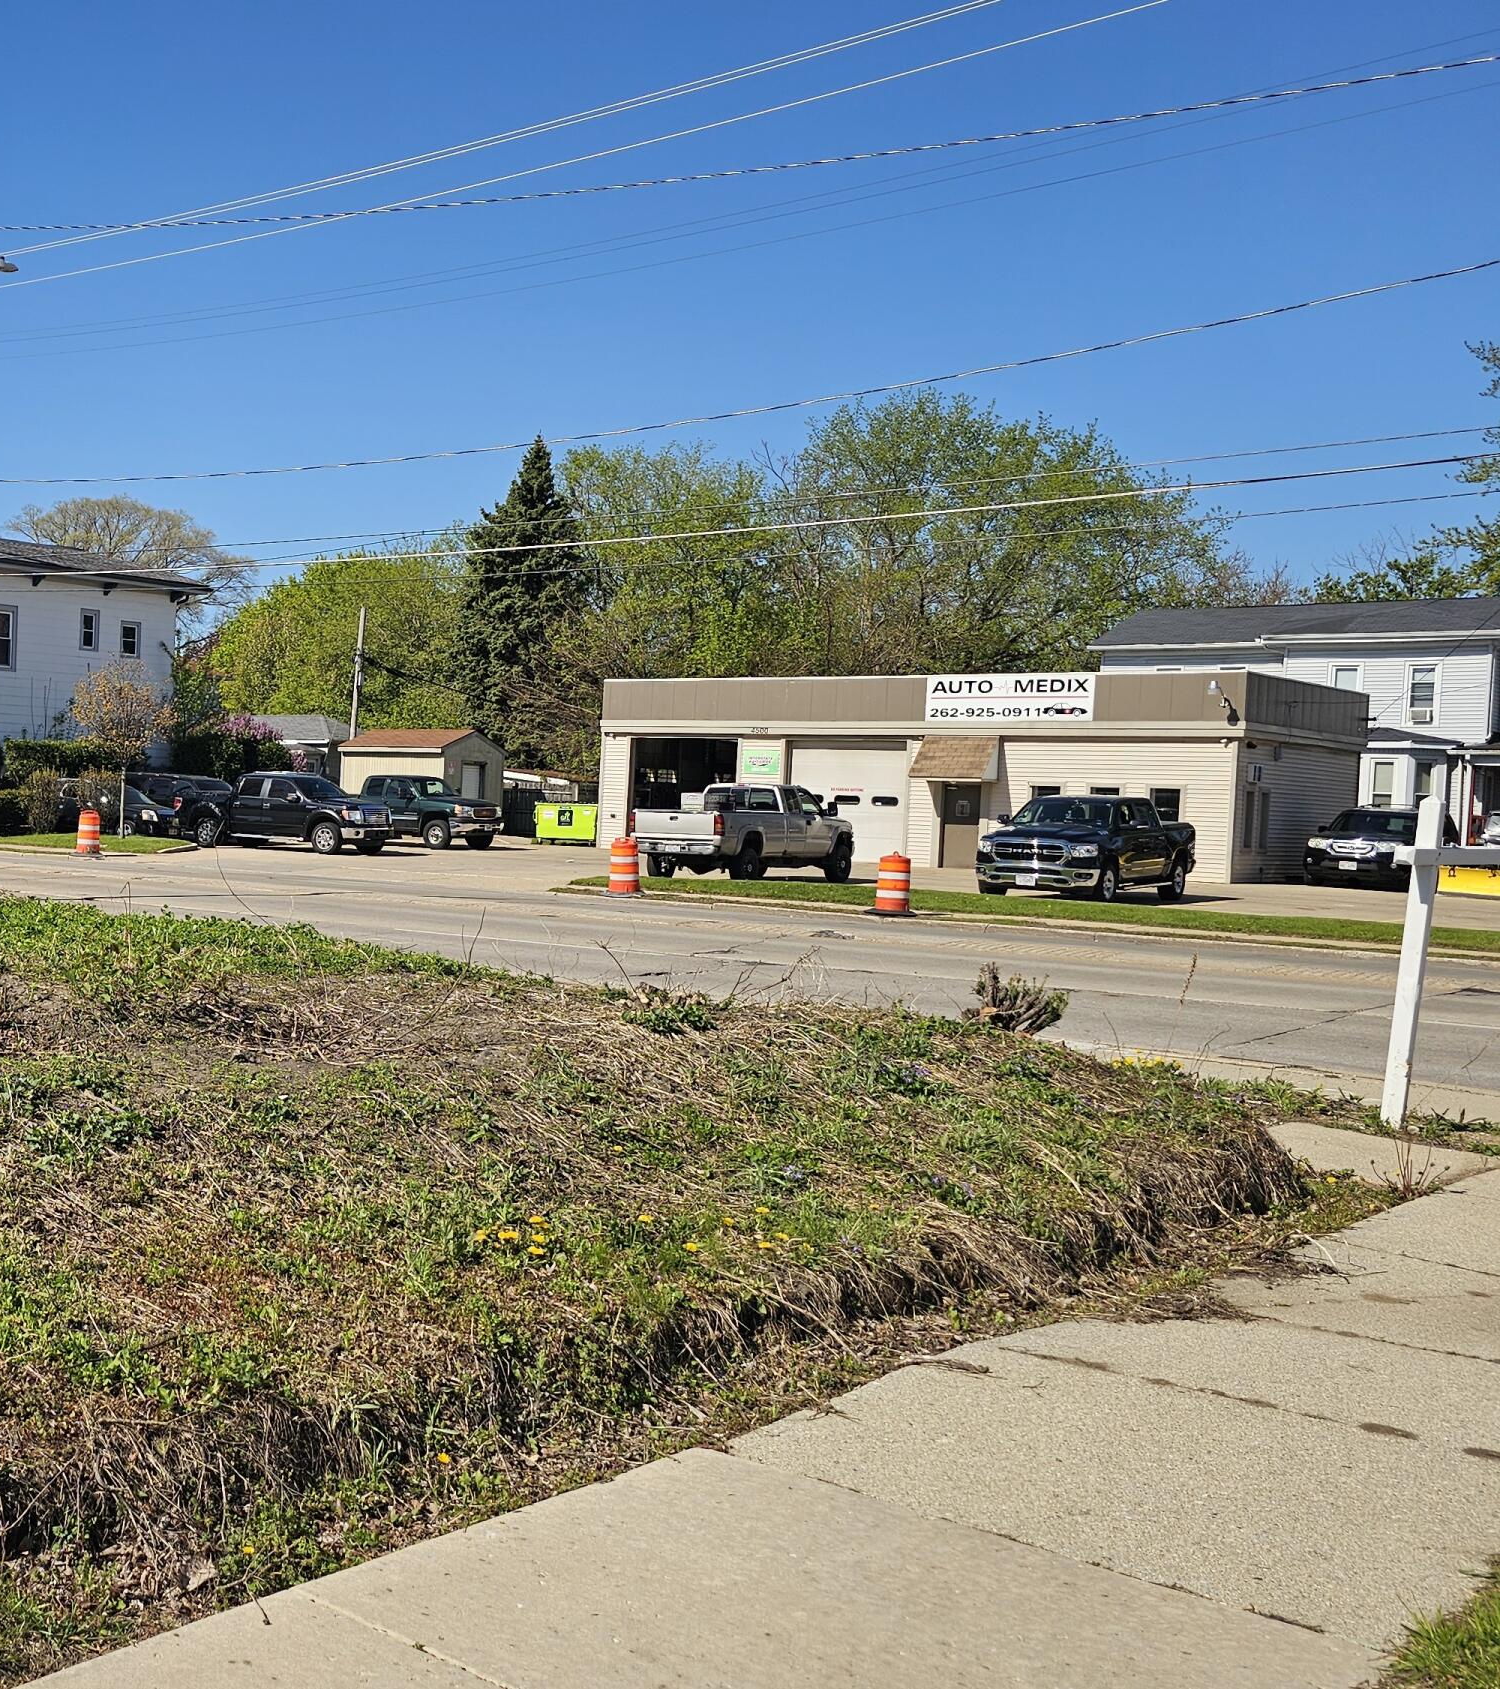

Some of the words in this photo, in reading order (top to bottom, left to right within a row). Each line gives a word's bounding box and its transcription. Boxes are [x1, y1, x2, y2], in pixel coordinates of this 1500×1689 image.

[931, 680, 993, 694] AUTO
[1013, 678, 1090, 693] MEDIX
[929, 707, 1042, 718] 262-925-0911
